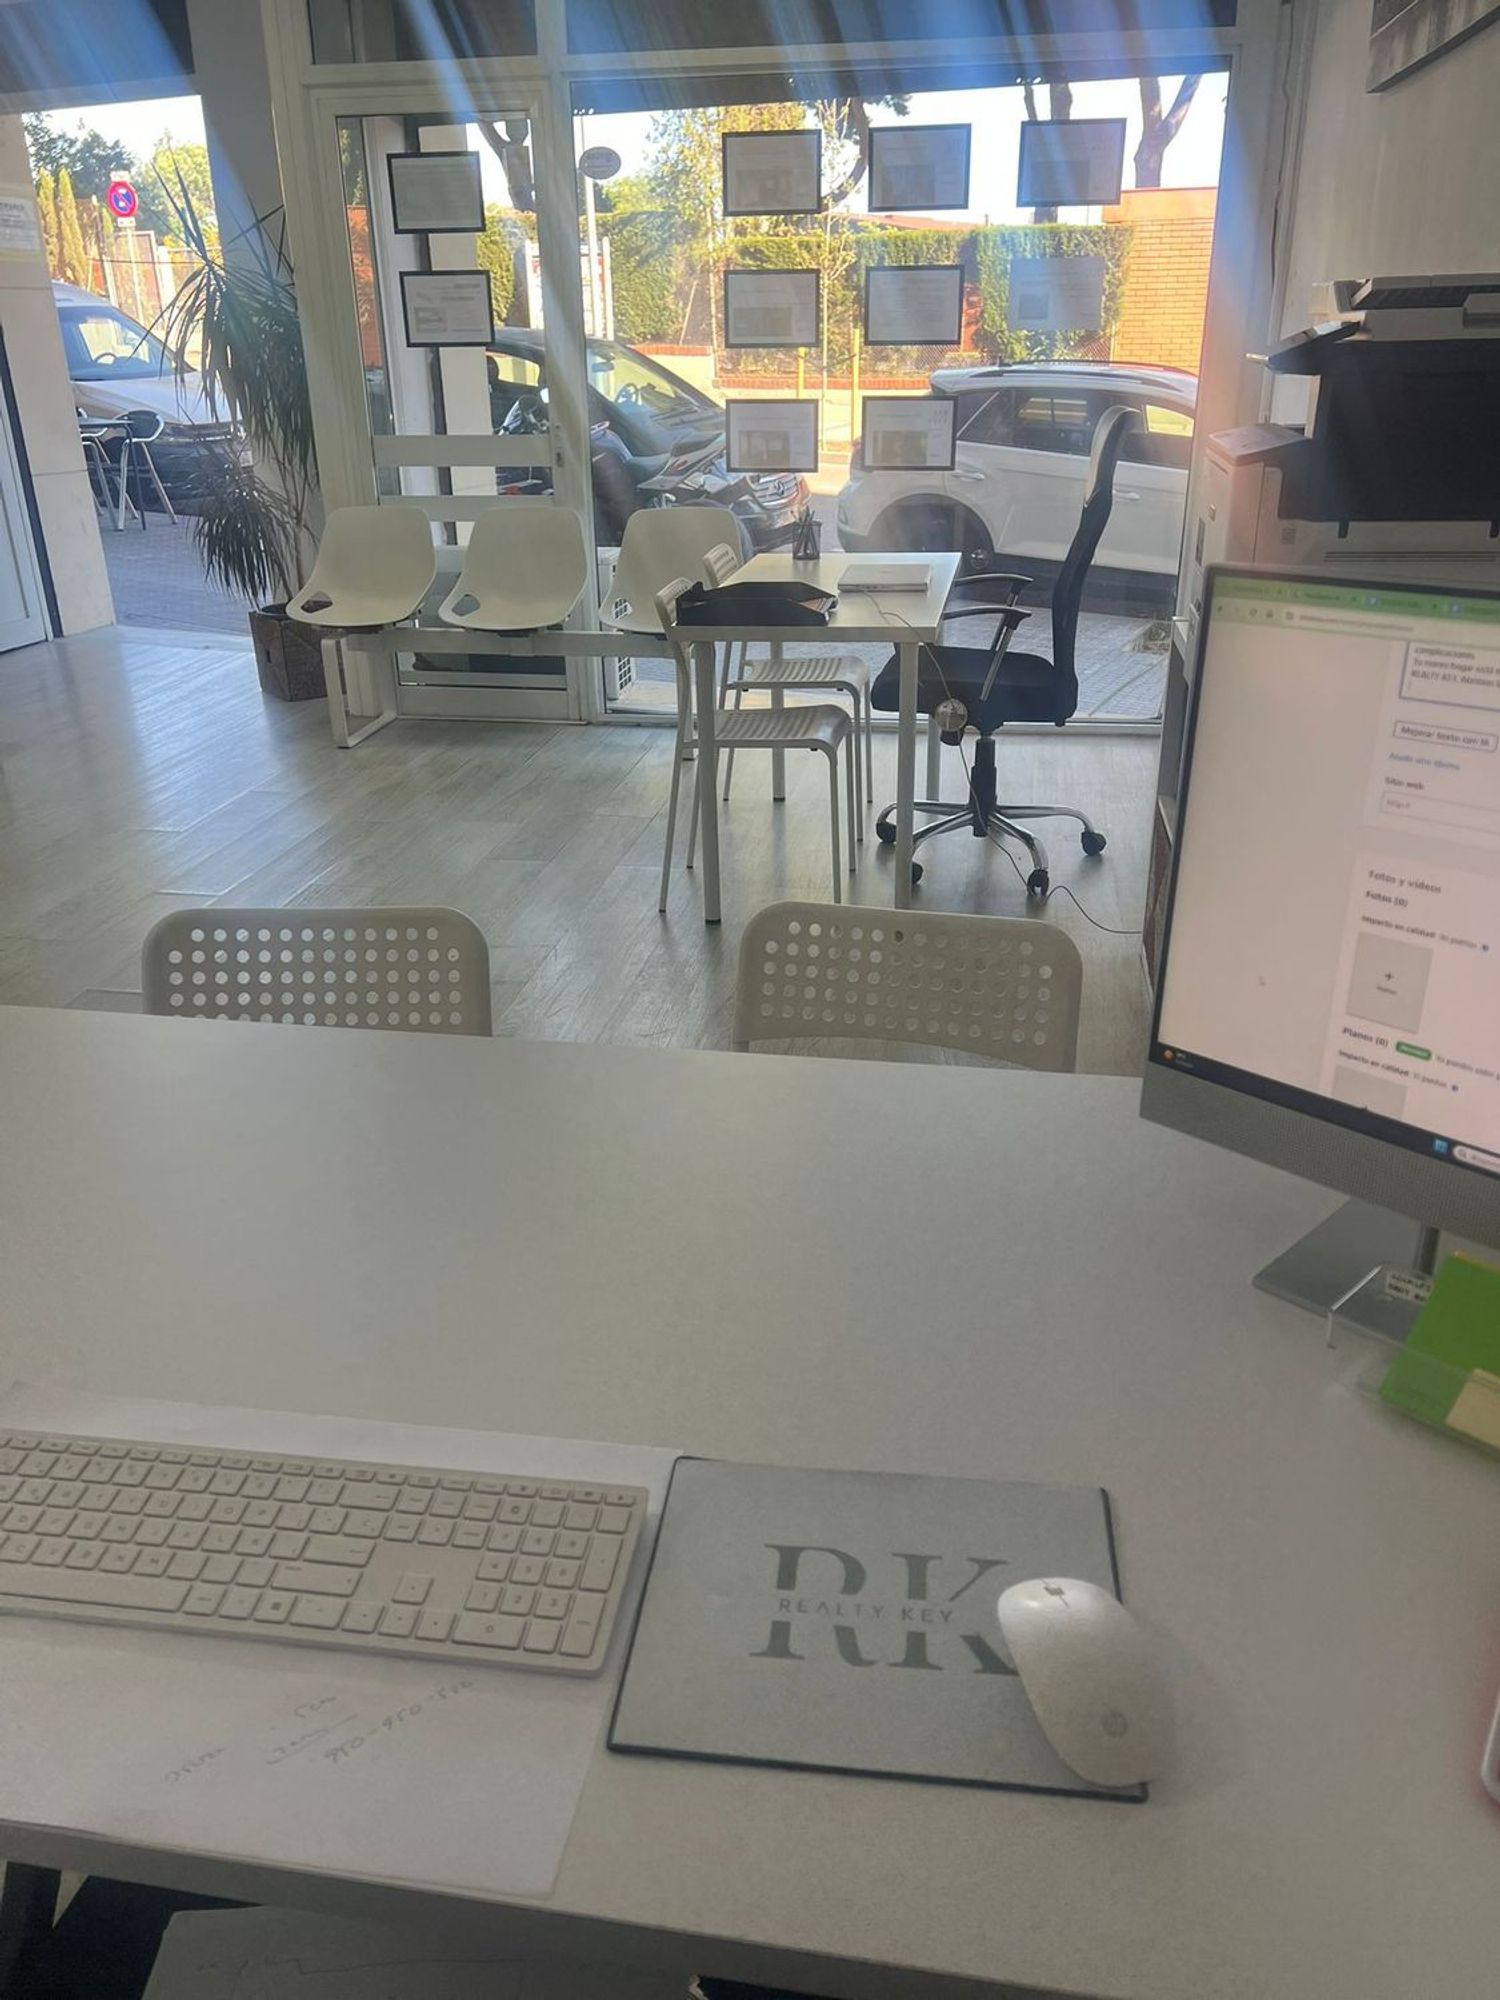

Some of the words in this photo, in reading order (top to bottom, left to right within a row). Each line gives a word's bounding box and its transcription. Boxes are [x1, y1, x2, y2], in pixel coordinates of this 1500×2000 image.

[1368, 869, 1397, 884] Fotos
[1365, 890, 1393, 904] Fotos
[1341, 1026, 1374, 1043] Planos
[749, 1543, 1019, 1677] RK
[779, 1598, 886, 1619] REALTY
[901, 1607, 954, 1624] KEY
